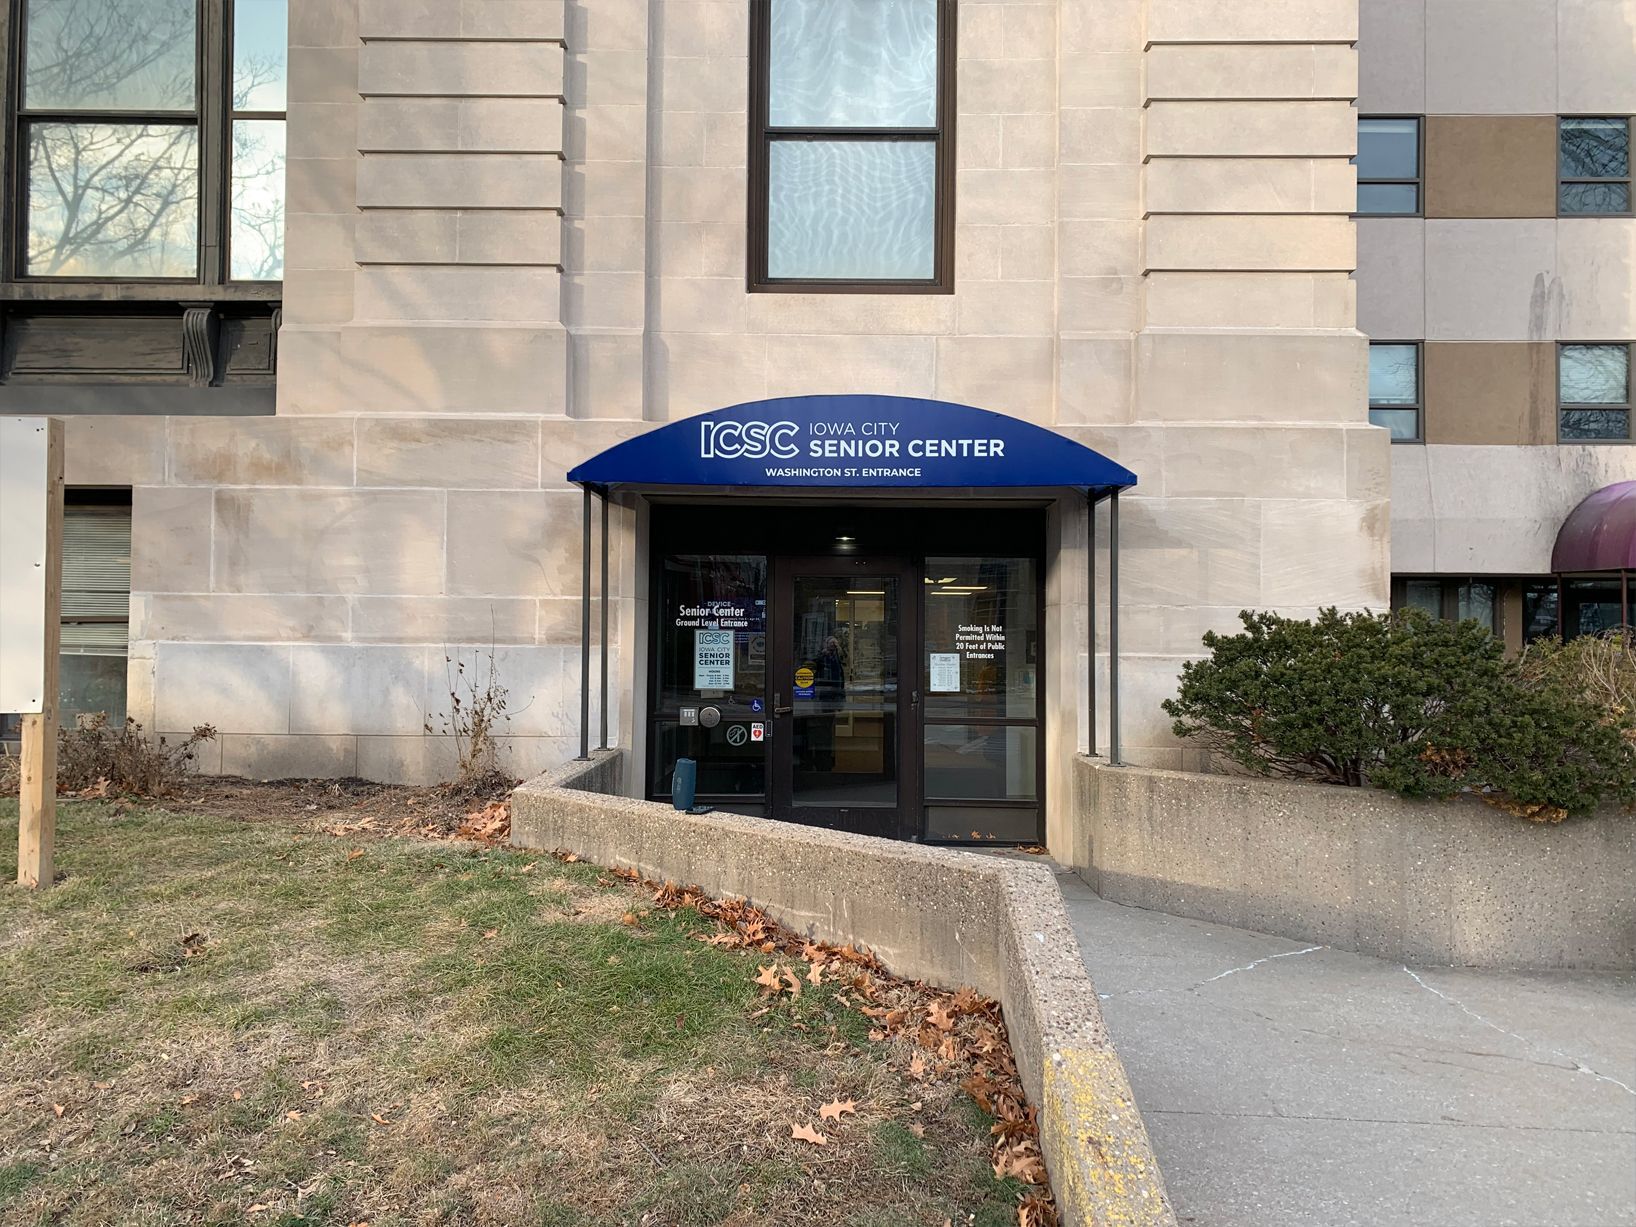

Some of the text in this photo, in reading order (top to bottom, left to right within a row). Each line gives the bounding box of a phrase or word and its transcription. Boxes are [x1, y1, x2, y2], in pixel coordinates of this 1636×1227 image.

[809, 422, 900, 435] IOWA CITY
[701, 421, 800, 458] ICSC
[809, 439, 1005, 457] SENIOR CENTER
[765, 468, 921, 477] WASHINGTON ST. ENTRANCE
[679, 604, 745, 617] Senior Center
[675, 618, 700, 627] Ground
[701, 618, 719, 627] Level
[720, 619, 748, 627] Entrance
[958, 624, 983, 633] Smoking
[984, 624, 990, 632] Is
[699, 632, 730, 645] ICSC
[955, 633, 1006, 641] Permitted Within
